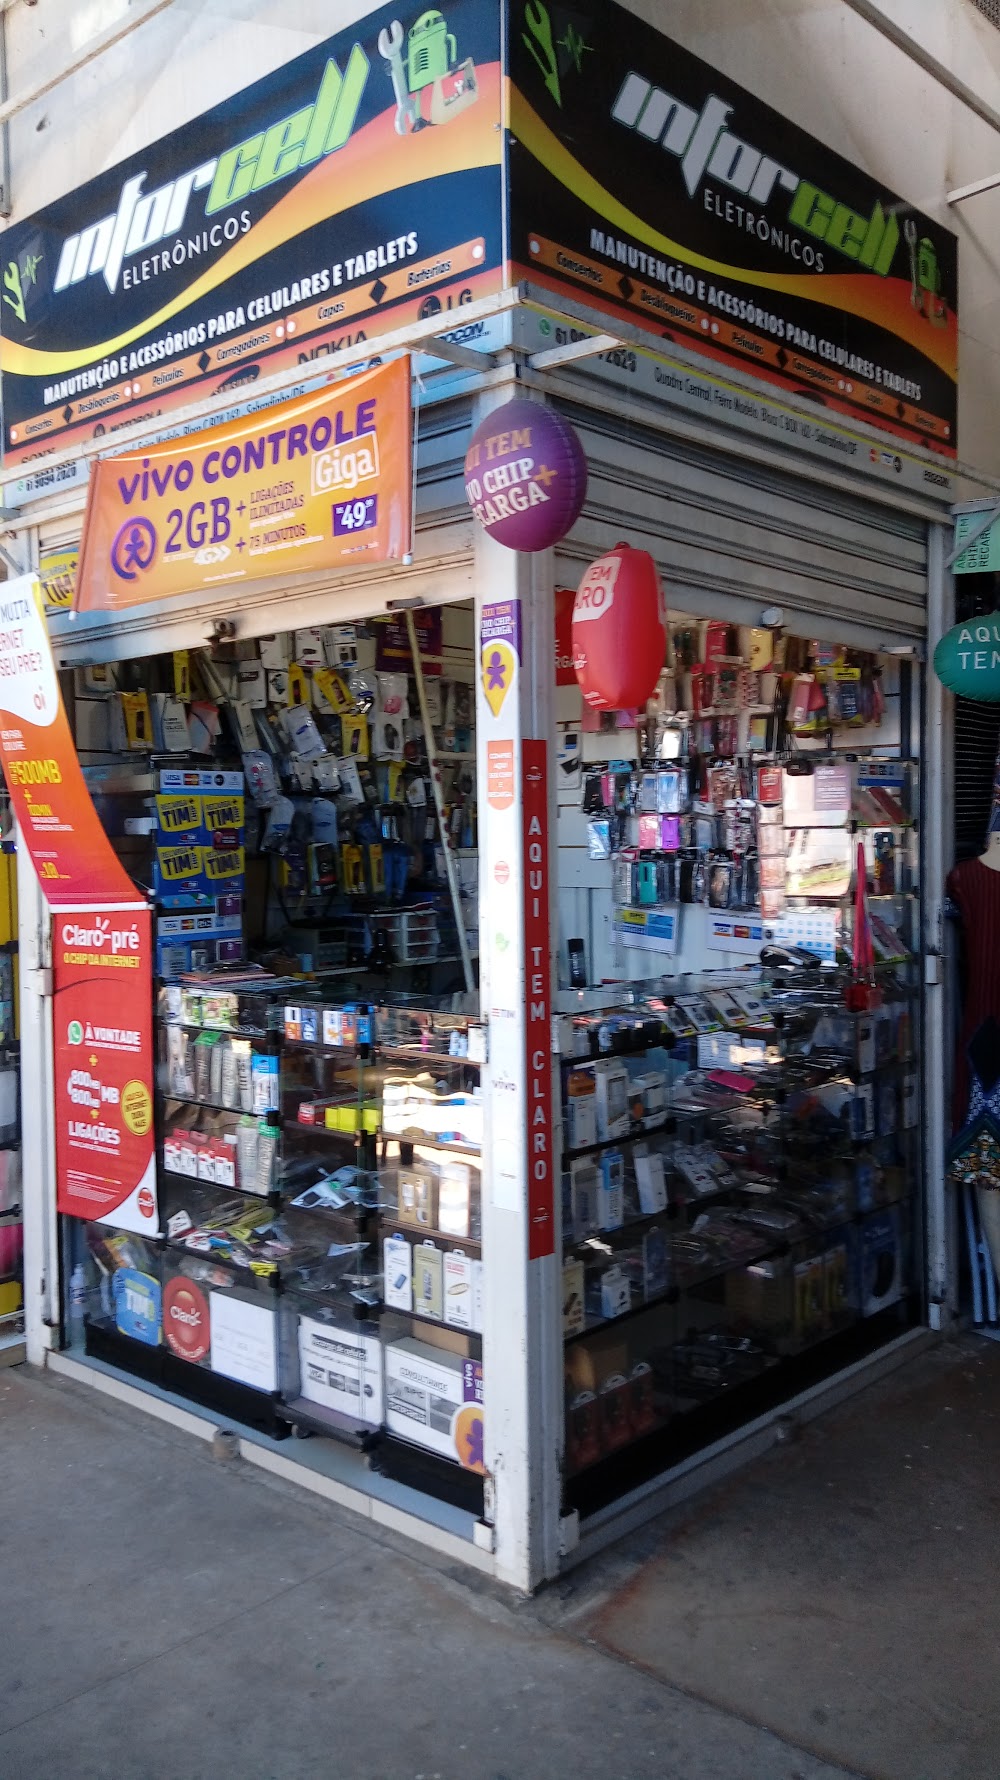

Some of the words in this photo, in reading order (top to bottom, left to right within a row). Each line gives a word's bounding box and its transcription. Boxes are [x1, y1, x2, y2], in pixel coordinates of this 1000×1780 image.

[122, 210, 252, 291] ELETRÔNICOS
[703, 188, 825, 273] ELETRÔNICOS
[317, 300, 345, 320] Capas
[406, 259, 452, 288] Baterias
[590, 228, 695, 295] MANUTENÇÃO
[697, 280, 706, 301] E
[708, 286, 785, 337] ACESSÓRIOS
[785, 323, 818, 354] PARA
[818, 338, 875, 380] CELULARES
[875, 366, 882, 384] E
[882, 369, 922, 401] TABLETS
[44, 357, 119, 406] MANUTENÇÃO
[120, 356, 128, 374] E
[129, 325, 206, 372] ACESSÓRIOS
[208, 309, 245, 338] PARA
[248, 268, 330, 322] CELULARES
[332, 263, 343, 287] E
[344, 231, 418, 281] TABLETS
[296, 330, 368, 365] NOKIA
[202, 398, 377, 484] CONTROLE
[484, 427, 533, 461] TEM
[314, 446, 375, 490] Giga
[483, 457, 536, 494] CHIP
[164, 496, 231, 556] 2GB
[162, 805, 191, 827] TIM
[207, 806, 235, 828] TIM
[162, 853, 191, 876] TIM
[207, 853, 235, 876] TIM
[527, 815, 543, 918] AQUI
[529, 946, 546, 1022] TEM
[93, 1026, 141, 1046] VONTADE
[68, 1120, 121, 1145] LIGAÇÕES
[531, 1050, 548, 1180] CLARO
